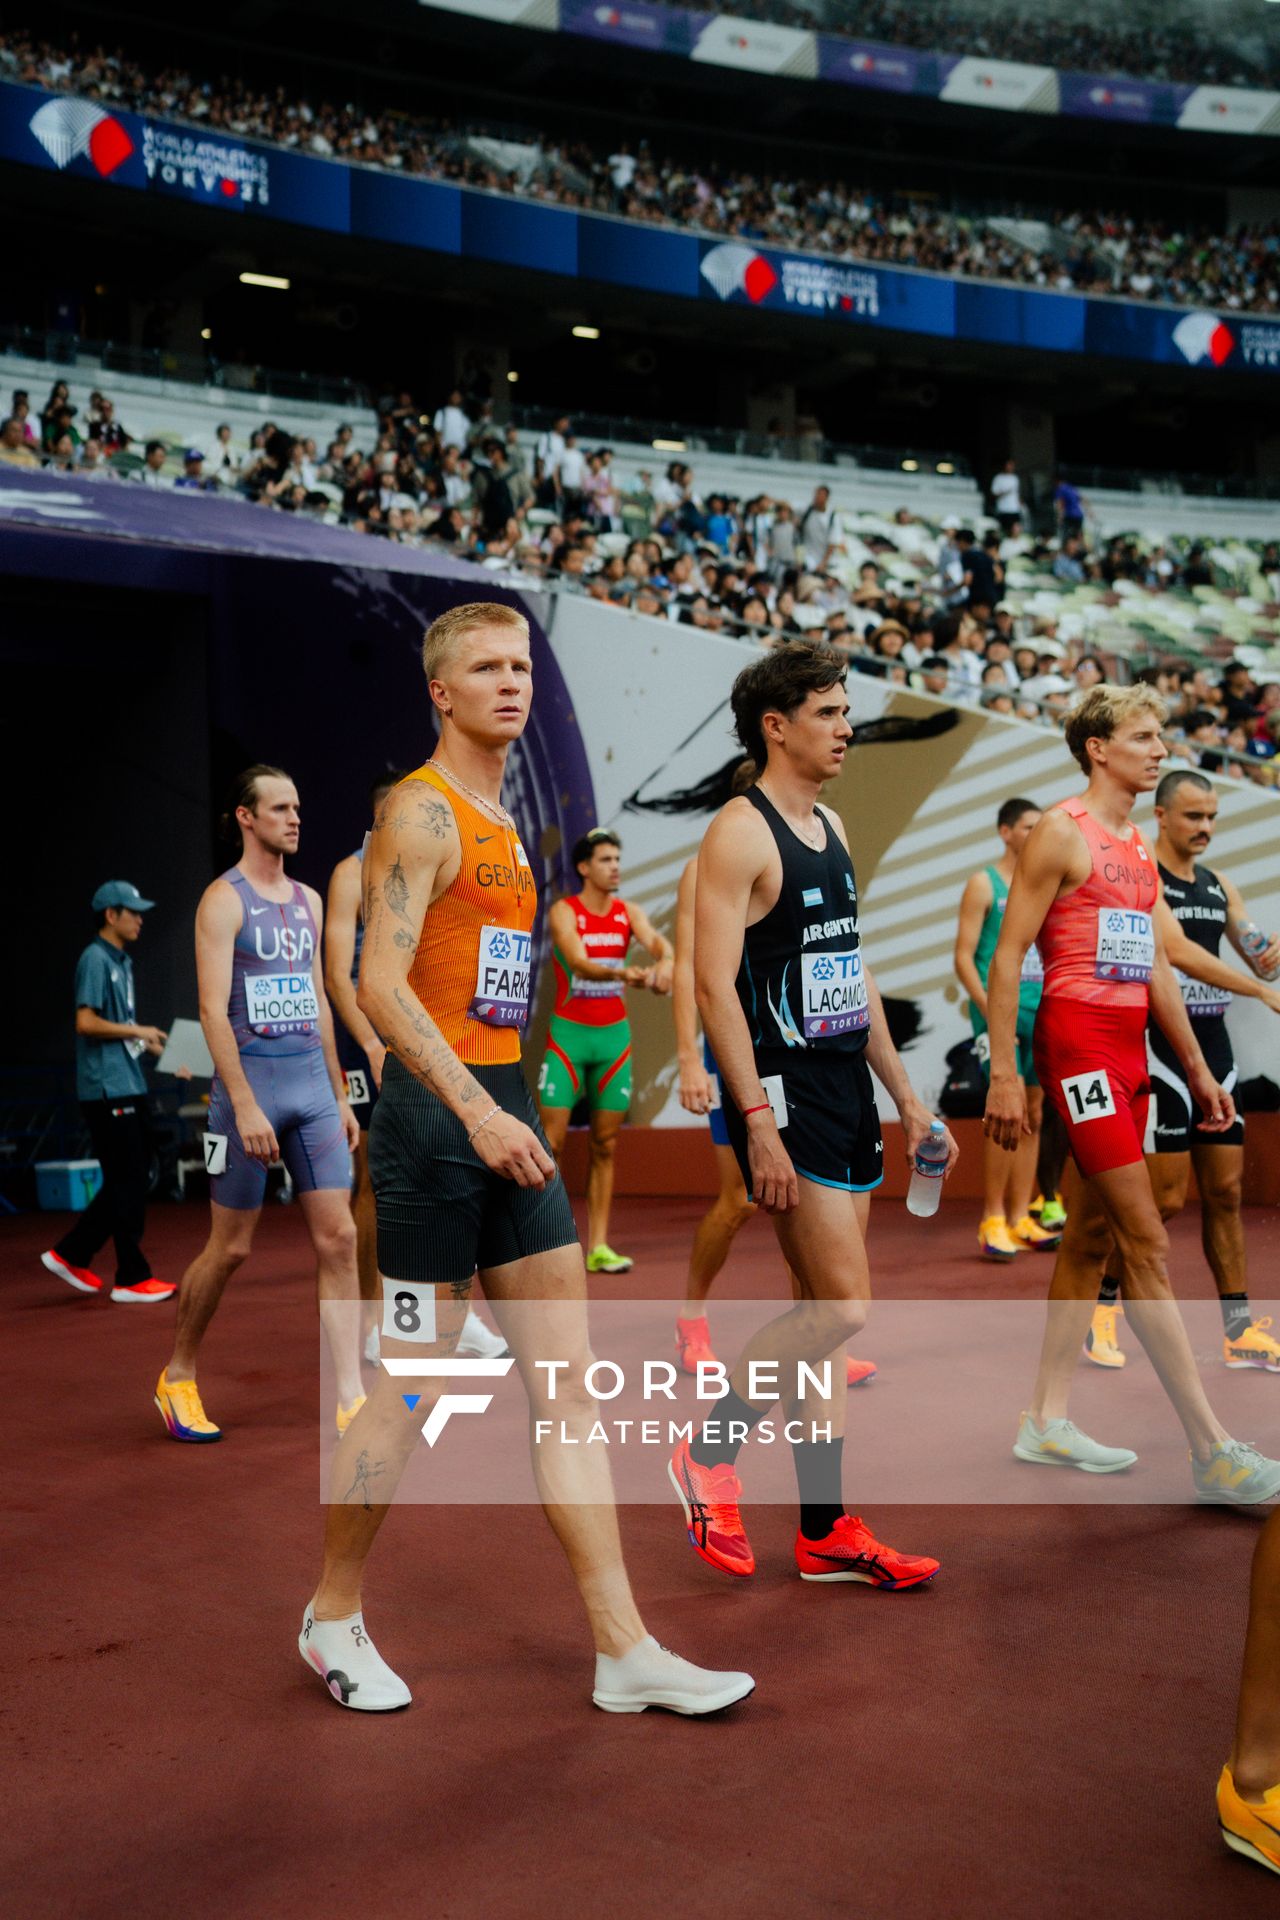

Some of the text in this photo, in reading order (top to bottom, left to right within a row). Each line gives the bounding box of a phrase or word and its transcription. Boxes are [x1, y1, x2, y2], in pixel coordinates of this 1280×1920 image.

[255, 926, 314, 961] USA
[271, 976, 312, 995] TDK
[253, 999, 317, 1020] HOCKER
[349, 1076, 365, 1099] 13
[1068, 1079, 1108, 1115] 14
[207, 1140, 218, 1167] 7
[393, 1291, 421, 1334] 8
